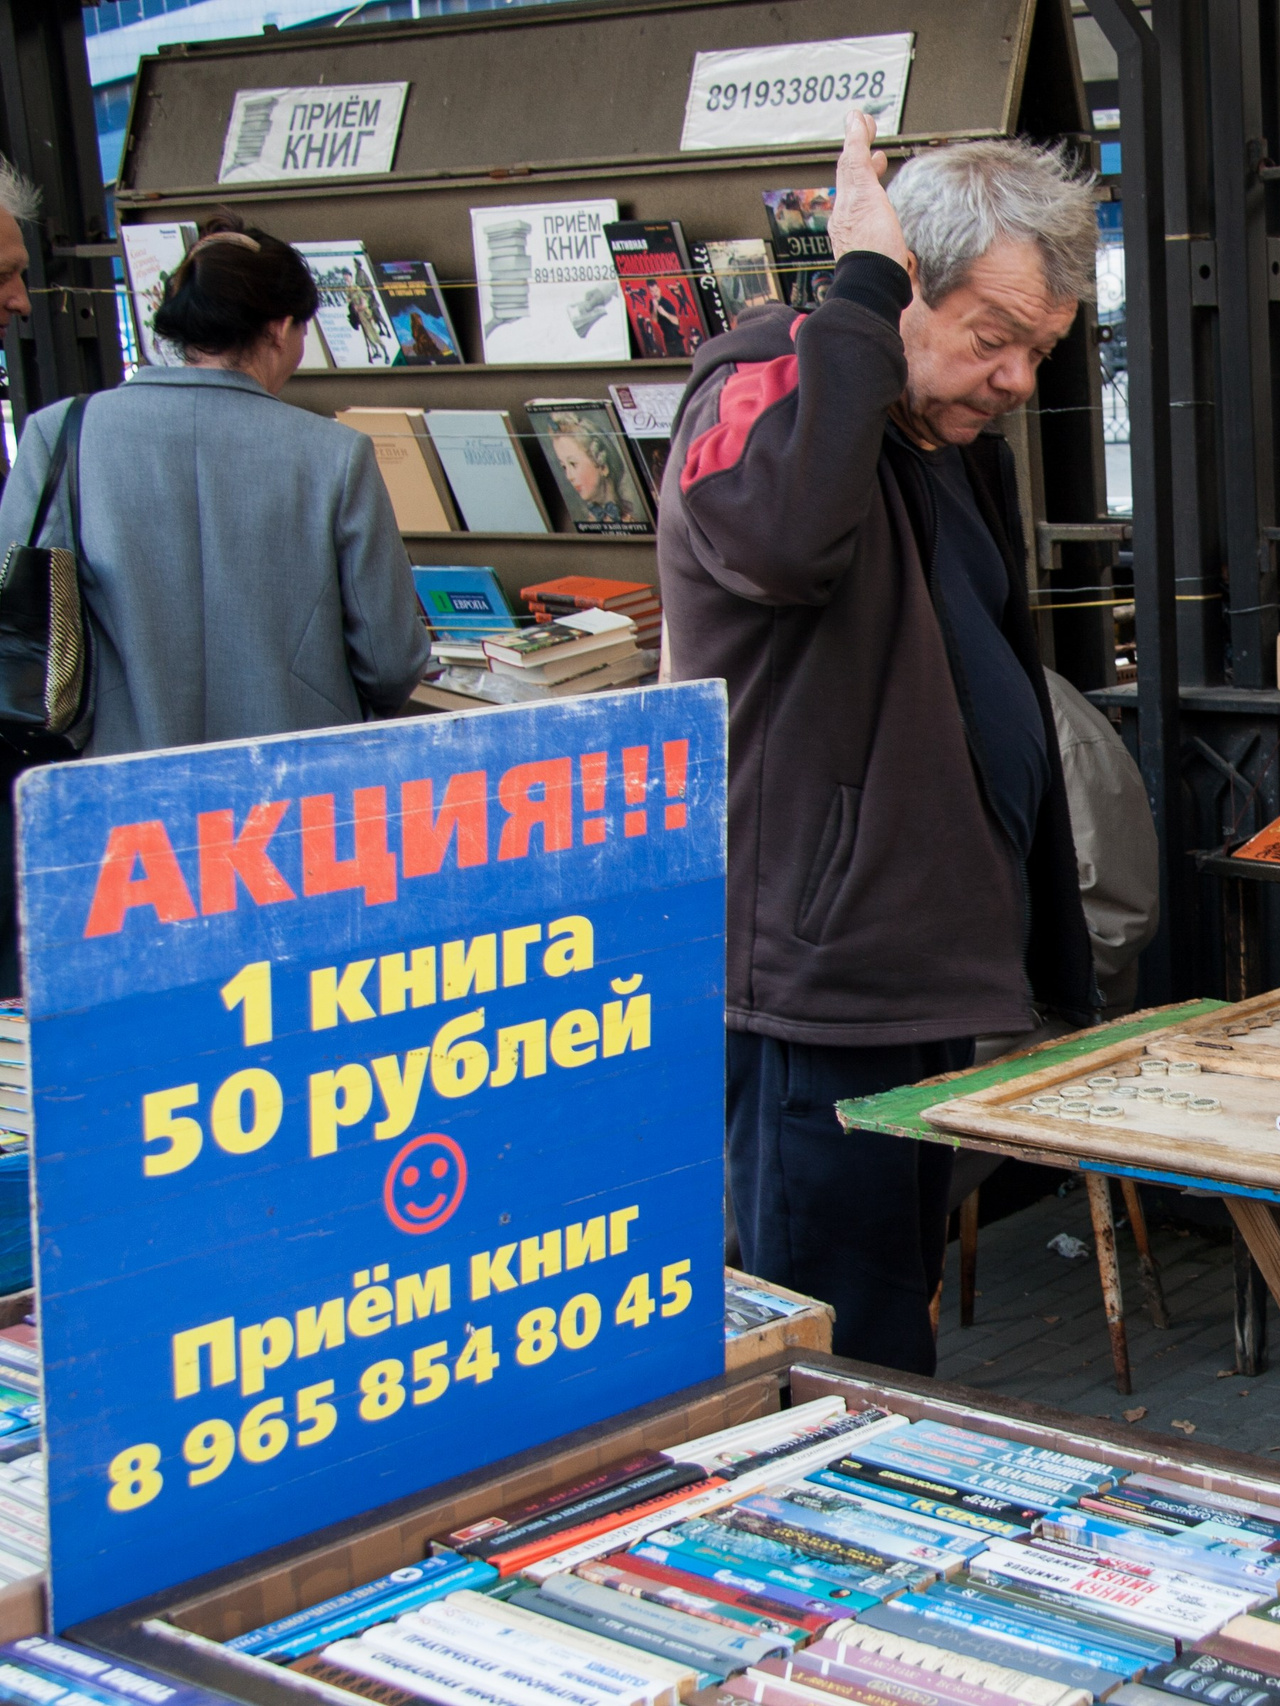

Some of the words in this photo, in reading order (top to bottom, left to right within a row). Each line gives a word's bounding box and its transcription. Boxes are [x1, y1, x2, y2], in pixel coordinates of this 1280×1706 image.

[705, 70, 886, 112] 89193380328
[288, 96, 381, 131] ПРИЁМ
[281, 130, 377, 171] КНИГ
[543, 210, 601, 234] ПРИЁМ
[545, 234, 601, 261] КНИГ
[611, 238, 648, 252] АКТИВНАЯ
[534, 265, 616, 283] 89193380328
[453, 600, 490, 610] ЕВРОПА
[84, 739, 690, 938] АКЦИЯ!!!
[221, 961, 273, 1046] 1
[311, 915, 595, 1031] книга
[143, 1068, 283, 1177] 50
[311, 974, 652, 1158] рублей
[172, 1263, 452, 1399] Приём
[470, 1206, 640, 1301] книг
[108, 1443, 164, 1512] 8
[183, 1380, 338, 1487] 965
[359, 1326, 501, 1423] 854
[515, 1293, 602, 1366] 80
[615, 1259, 694, 1329] 45
[995, 1465, 1074, 1492] МАРИНИНА
[1015, 1455, 1092, 1481] МАРИНИНА
[1036, 1449, 1113, 1475] МАРИНИНА
[980, 1477, 1060, 1505] МАРИНИНА
[935, 1505, 1014, 1534] СЕРОВА
[1003, 1561, 1070, 1584] ВЛАДИМИР
[1071, 1579, 1145, 1607] КУНИН
[1023, 1550, 1087, 1571] ВЛАДИМИР
[1088, 1568, 1160, 1594] КУНИН
[402, 1633, 497, 1671] ПРАКТИЧЕСКАЯ
[371, 1653, 464, 1689] СПЕЦИАЛЬНАЯ
